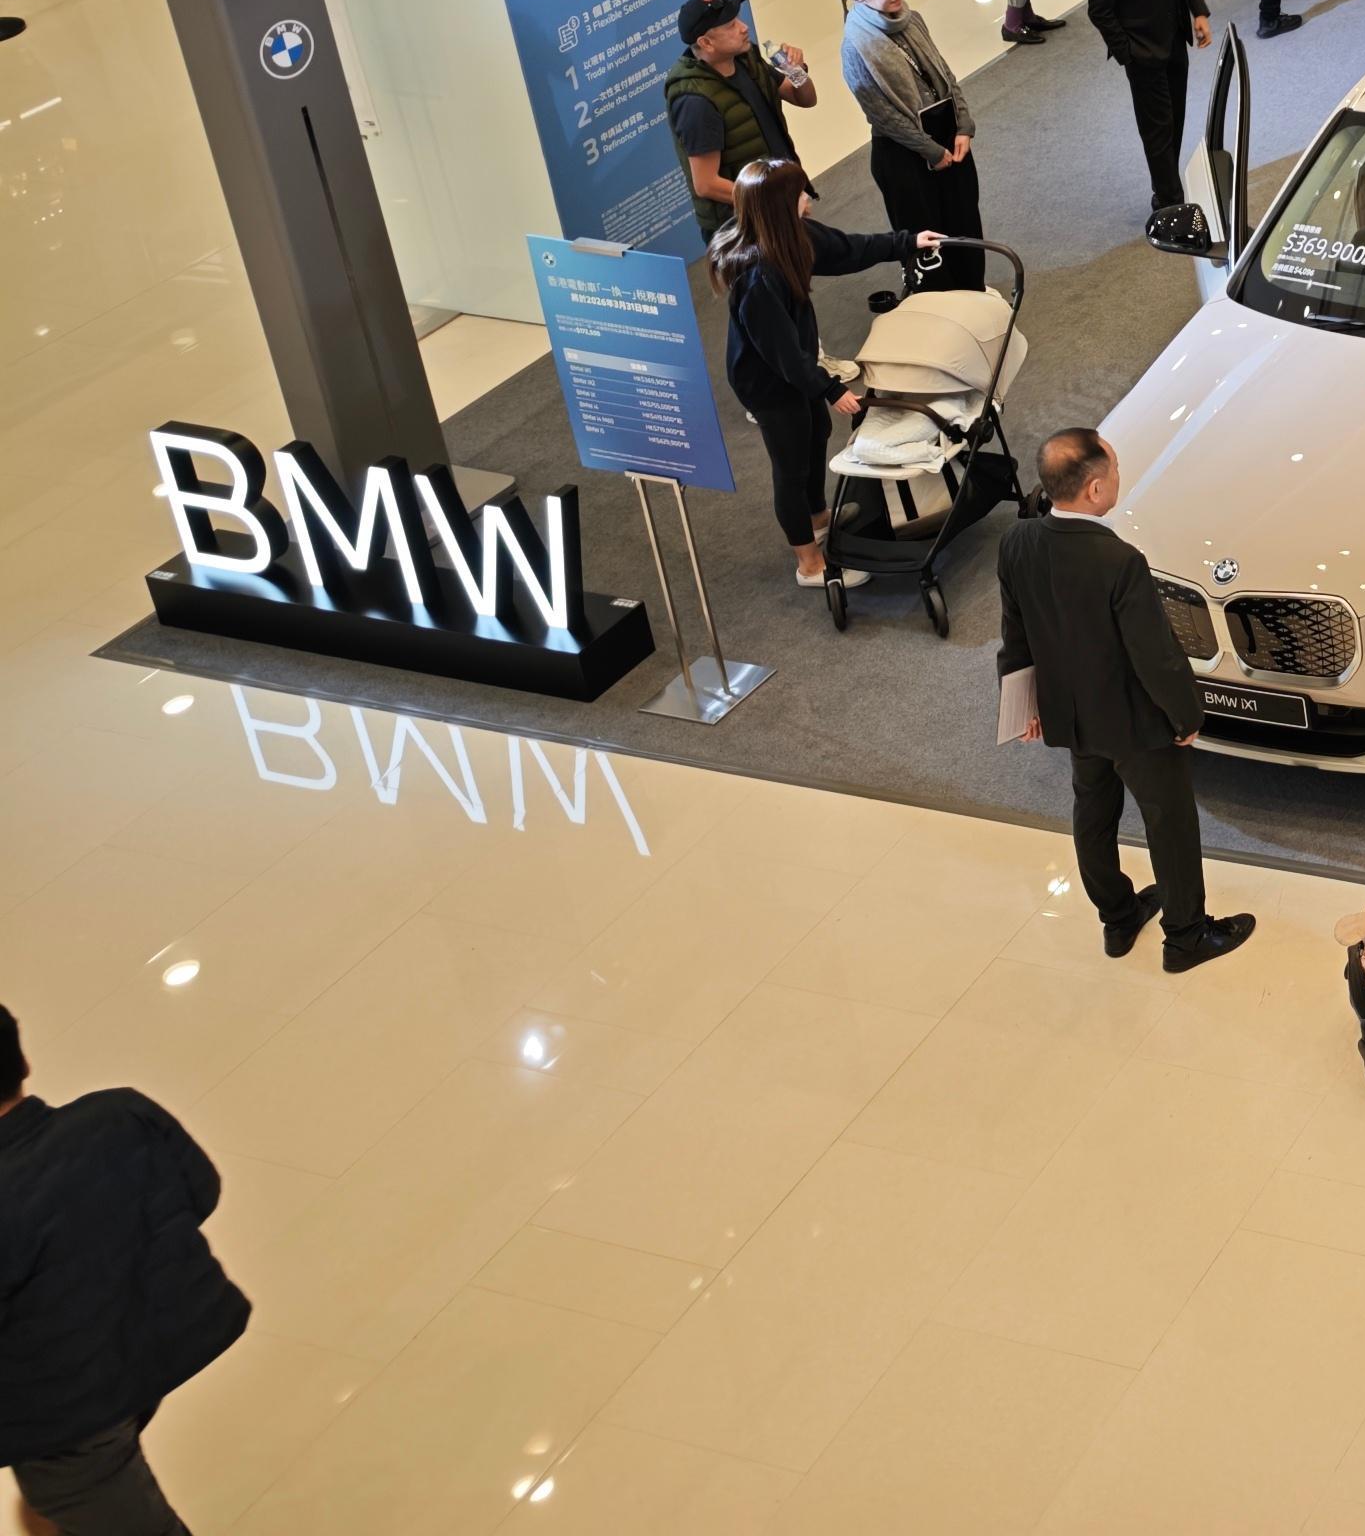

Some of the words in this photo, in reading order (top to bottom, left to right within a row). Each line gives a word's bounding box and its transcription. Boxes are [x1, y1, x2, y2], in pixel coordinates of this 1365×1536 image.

[586, 24, 592, 35] 3
[593, 9, 622, 31] Flexible
[606, 40, 626, 58] BMW
[630, 43, 650, 61] BMW
[565, 65, 580, 92] 1
[574, 100, 592, 129] 2
[583, 137, 600, 165] 3
[149, 424, 572, 630] BMW
[1204, 691, 1238, 708] BMW
[1241, 698, 1257, 712] iX1
